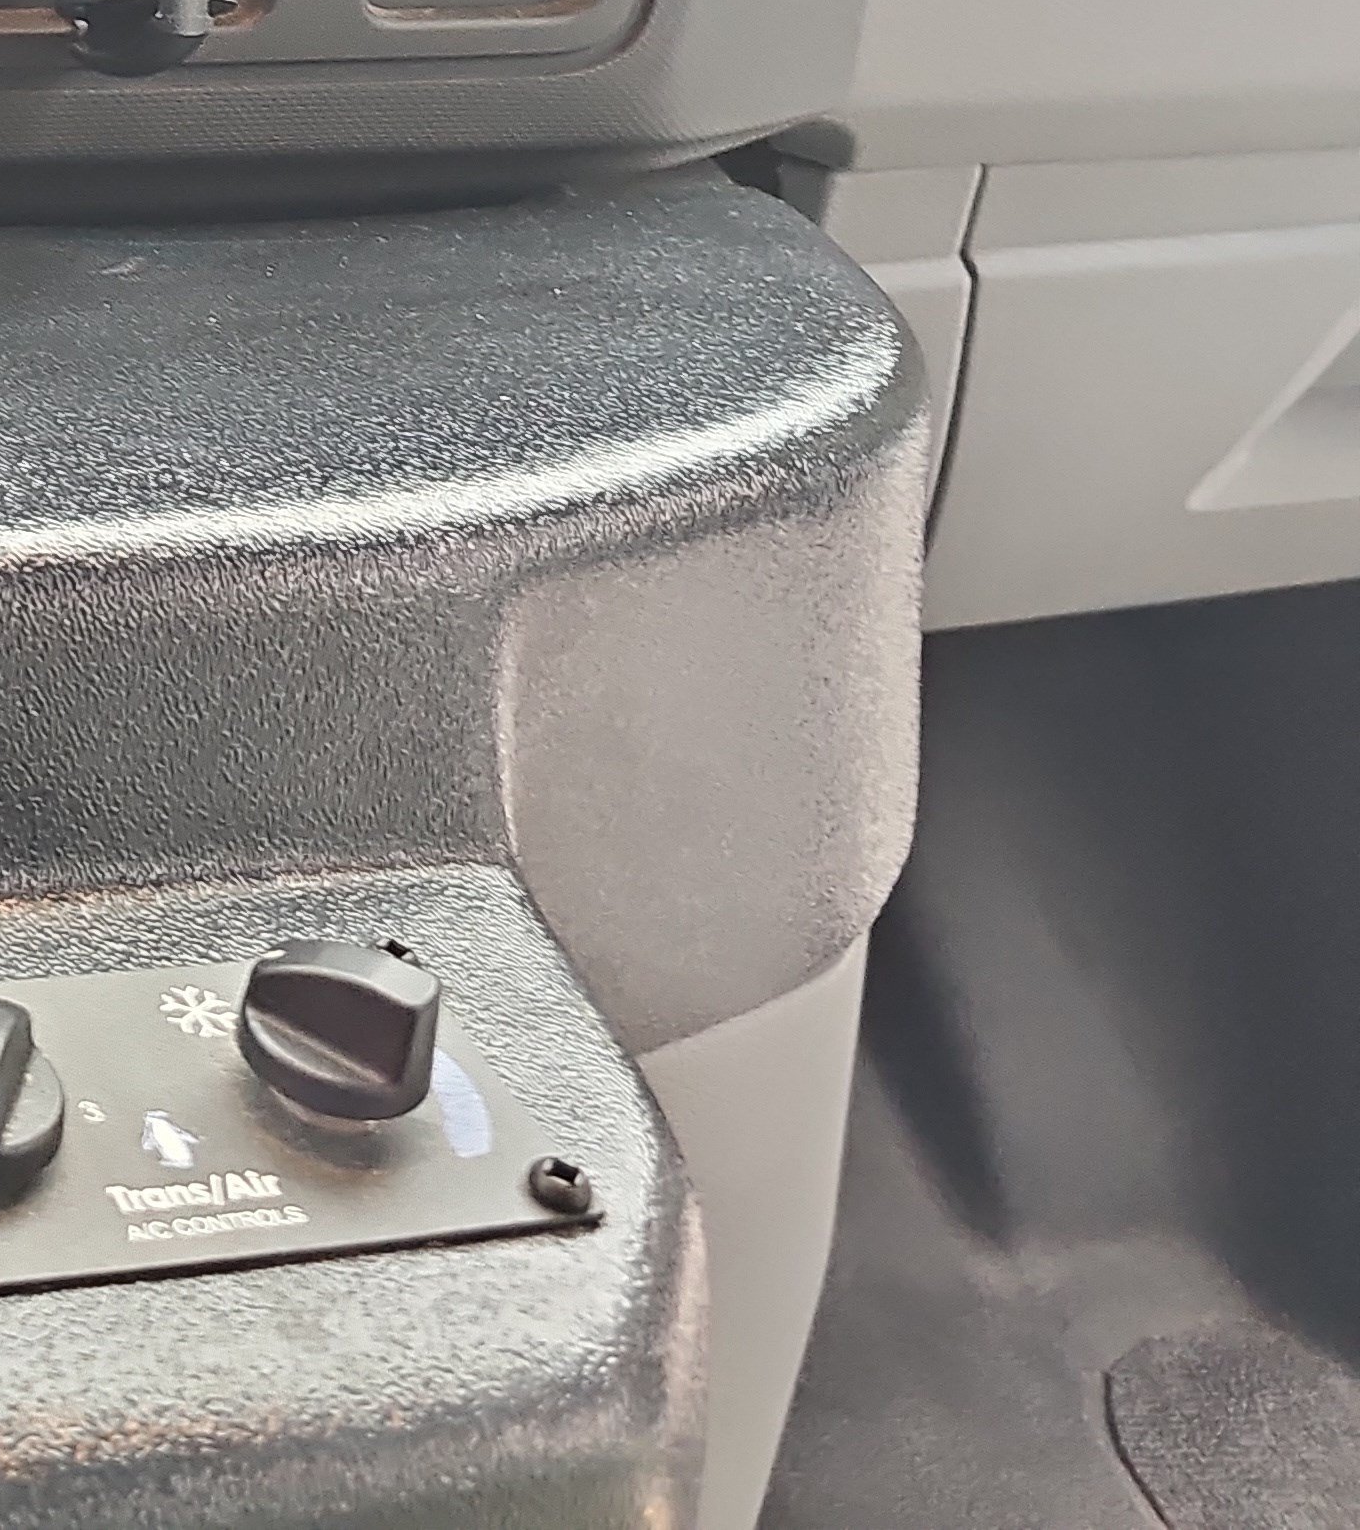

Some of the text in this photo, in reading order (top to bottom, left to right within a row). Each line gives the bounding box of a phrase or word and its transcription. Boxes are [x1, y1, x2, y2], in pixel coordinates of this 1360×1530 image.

[104, 1169, 284, 1214] Trans/Air
[127, 1205, 311, 1242] A/C CONTROLS
